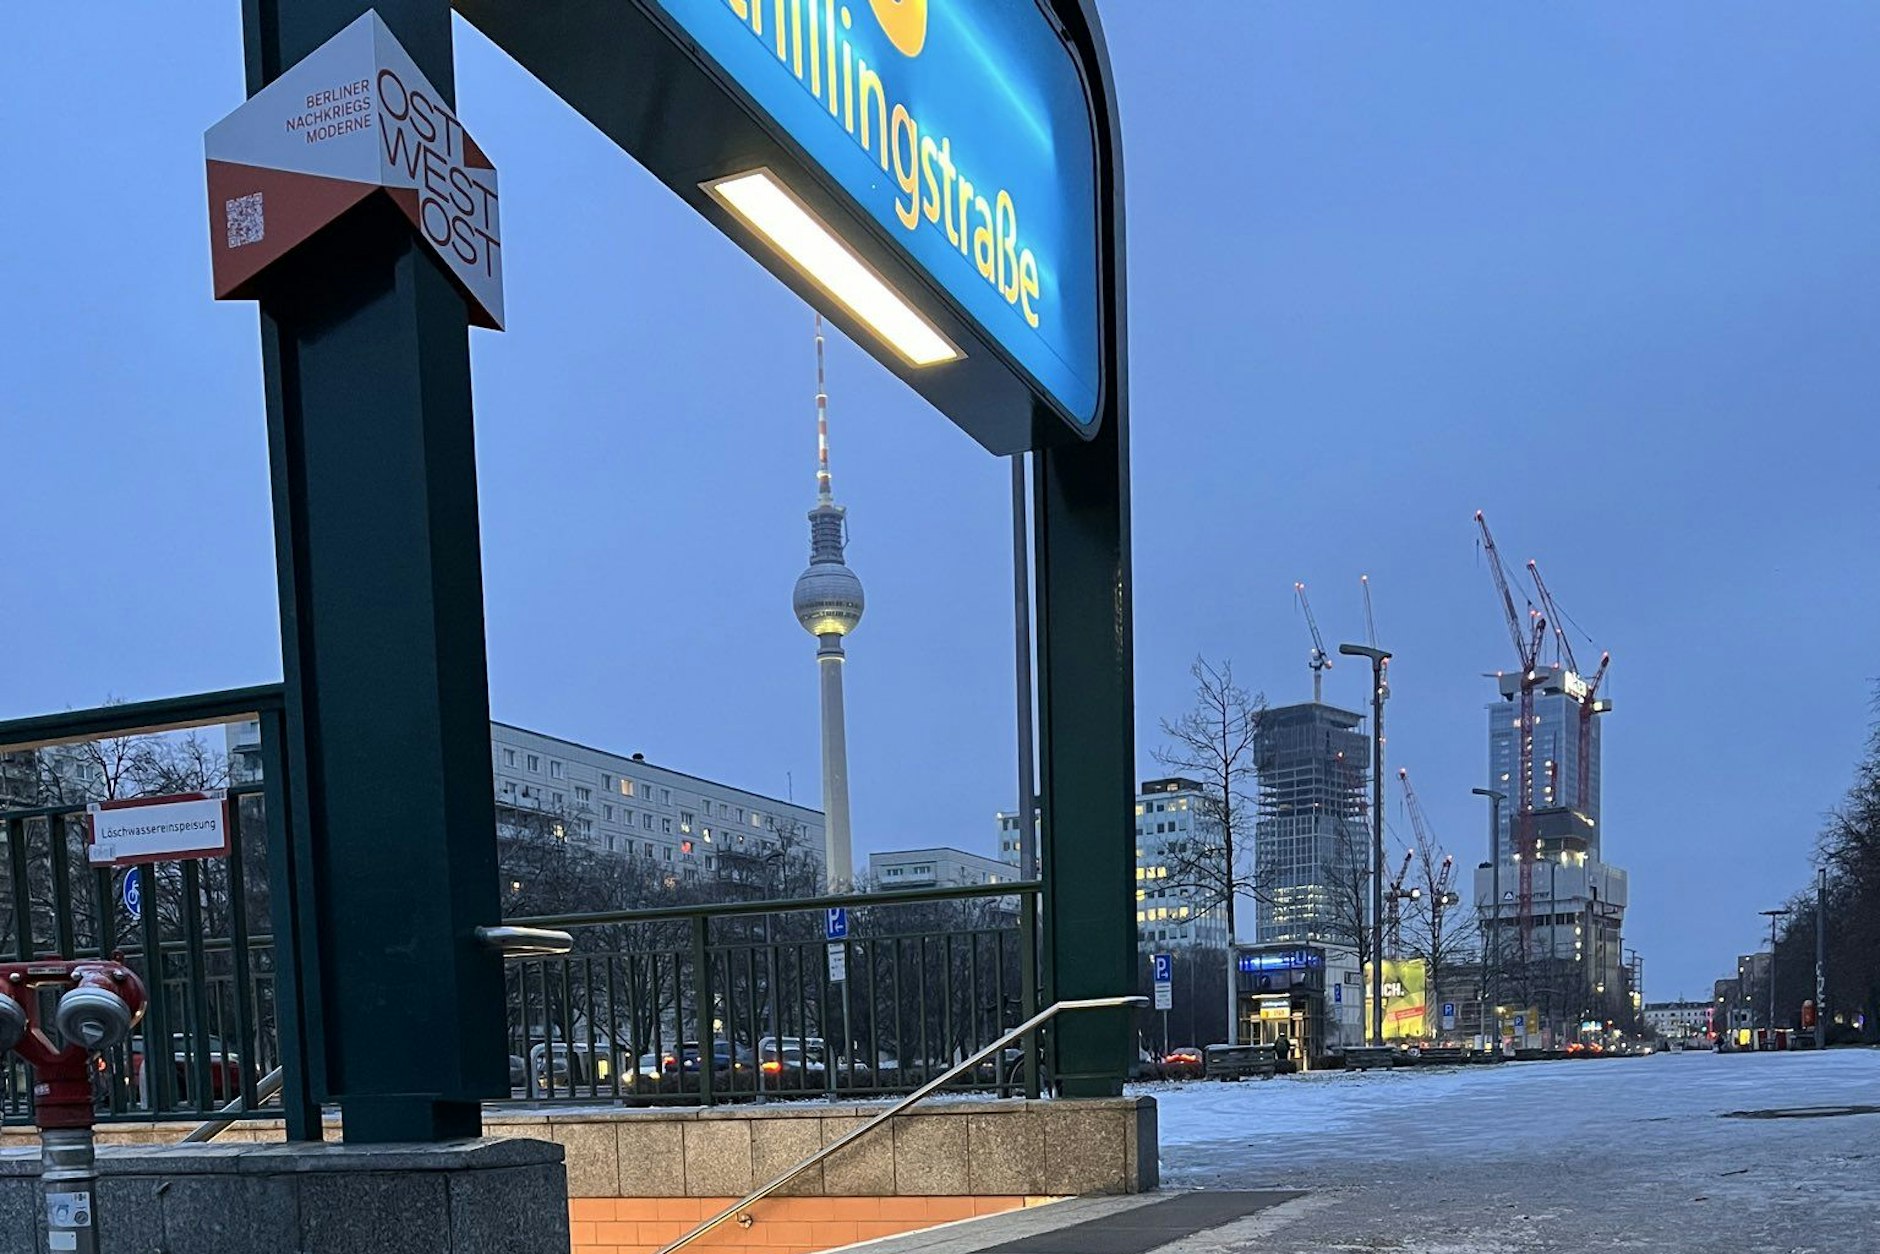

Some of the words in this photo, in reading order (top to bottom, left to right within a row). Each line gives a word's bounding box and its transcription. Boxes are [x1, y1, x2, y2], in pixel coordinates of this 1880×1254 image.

[306, 79, 370, 109] BERLINER
[286, 96, 371, 132] NACHKRIEGS
[306, 113, 372, 144] MODERNE
[377, 69, 461, 157] OST
[378, 111, 498, 230] WEST
[422, 197, 500, 278] OST
[101, 819, 217, 839] Löschwassereinspeisung
[1156, 957, 1167, 979] P
